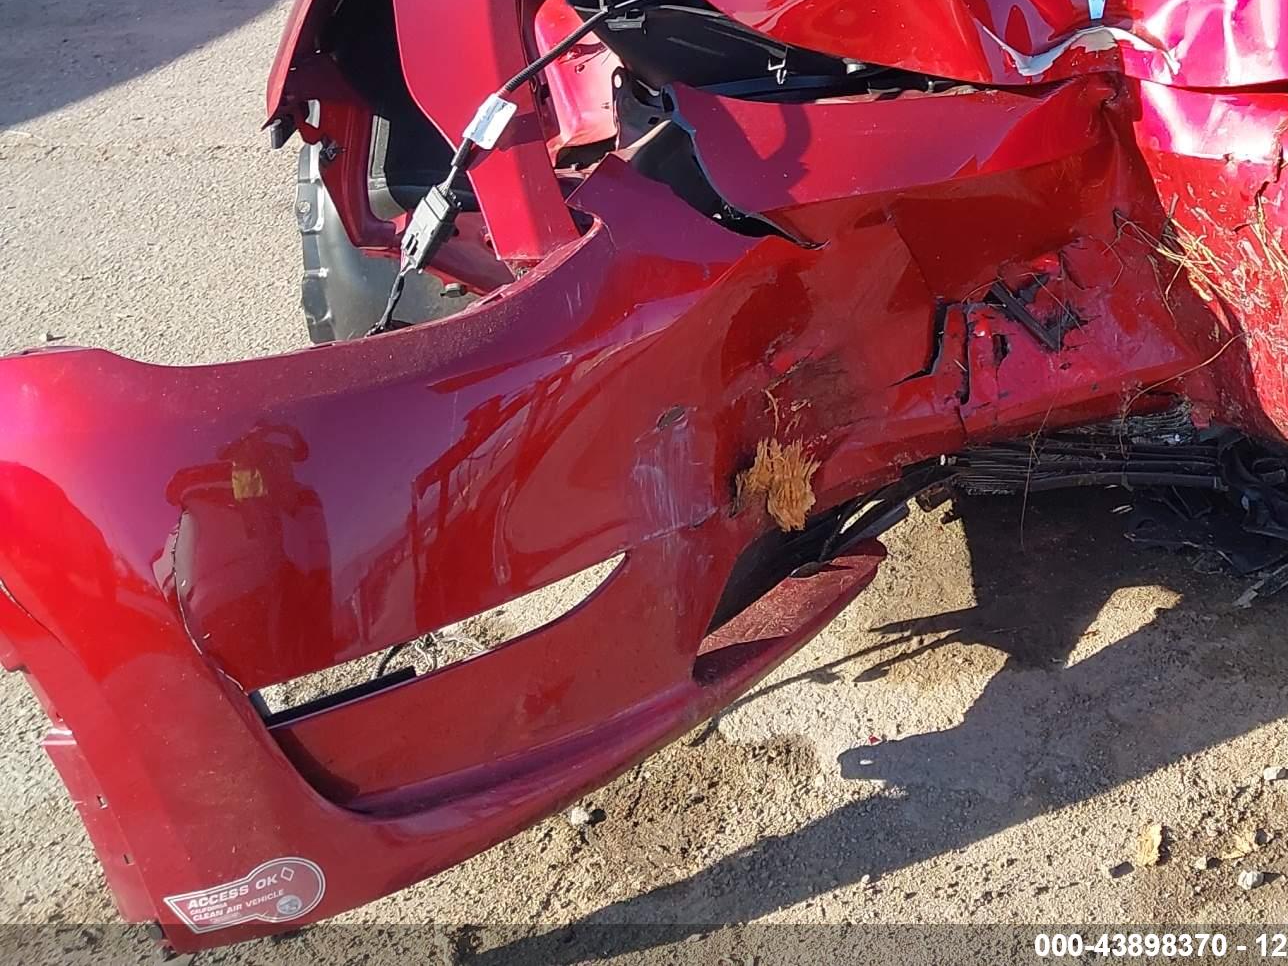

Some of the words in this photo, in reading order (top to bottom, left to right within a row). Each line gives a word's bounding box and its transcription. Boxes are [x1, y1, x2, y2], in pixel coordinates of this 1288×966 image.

[188, 884, 249, 910] ACCESS
[255, 874, 279, 890] OK
[193, 910, 224, 922] CLEAN
[226, 904, 243, 914] AIR
[245, 889, 285, 908] VEHICLE
